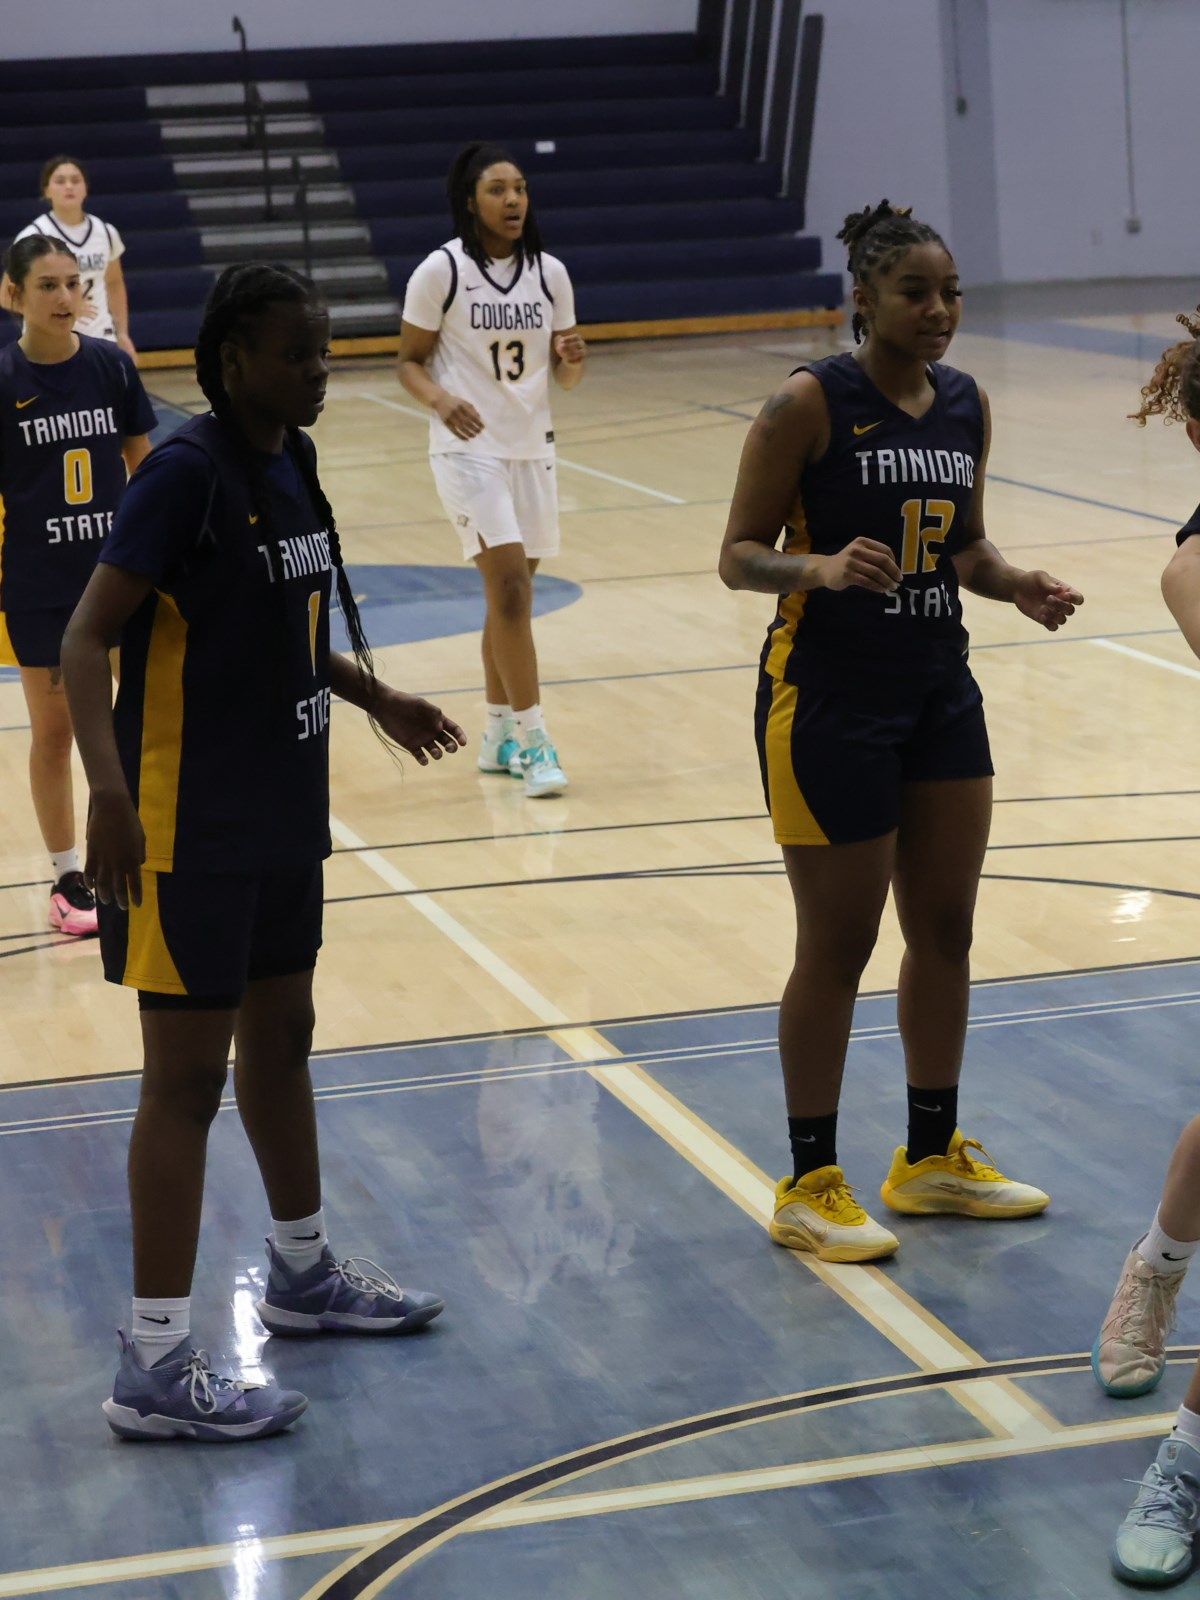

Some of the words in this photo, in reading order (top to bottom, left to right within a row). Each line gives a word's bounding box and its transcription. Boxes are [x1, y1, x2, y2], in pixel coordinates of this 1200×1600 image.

[471, 303, 543, 330] COUGARS
[489, 340, 525, 382] 13
[63, 448, 93, 505] 0
[855, 448, 974, 489] TRINIDAD
[901, 498, 955, 575] 12
[307, 590, 322, 677] 1
